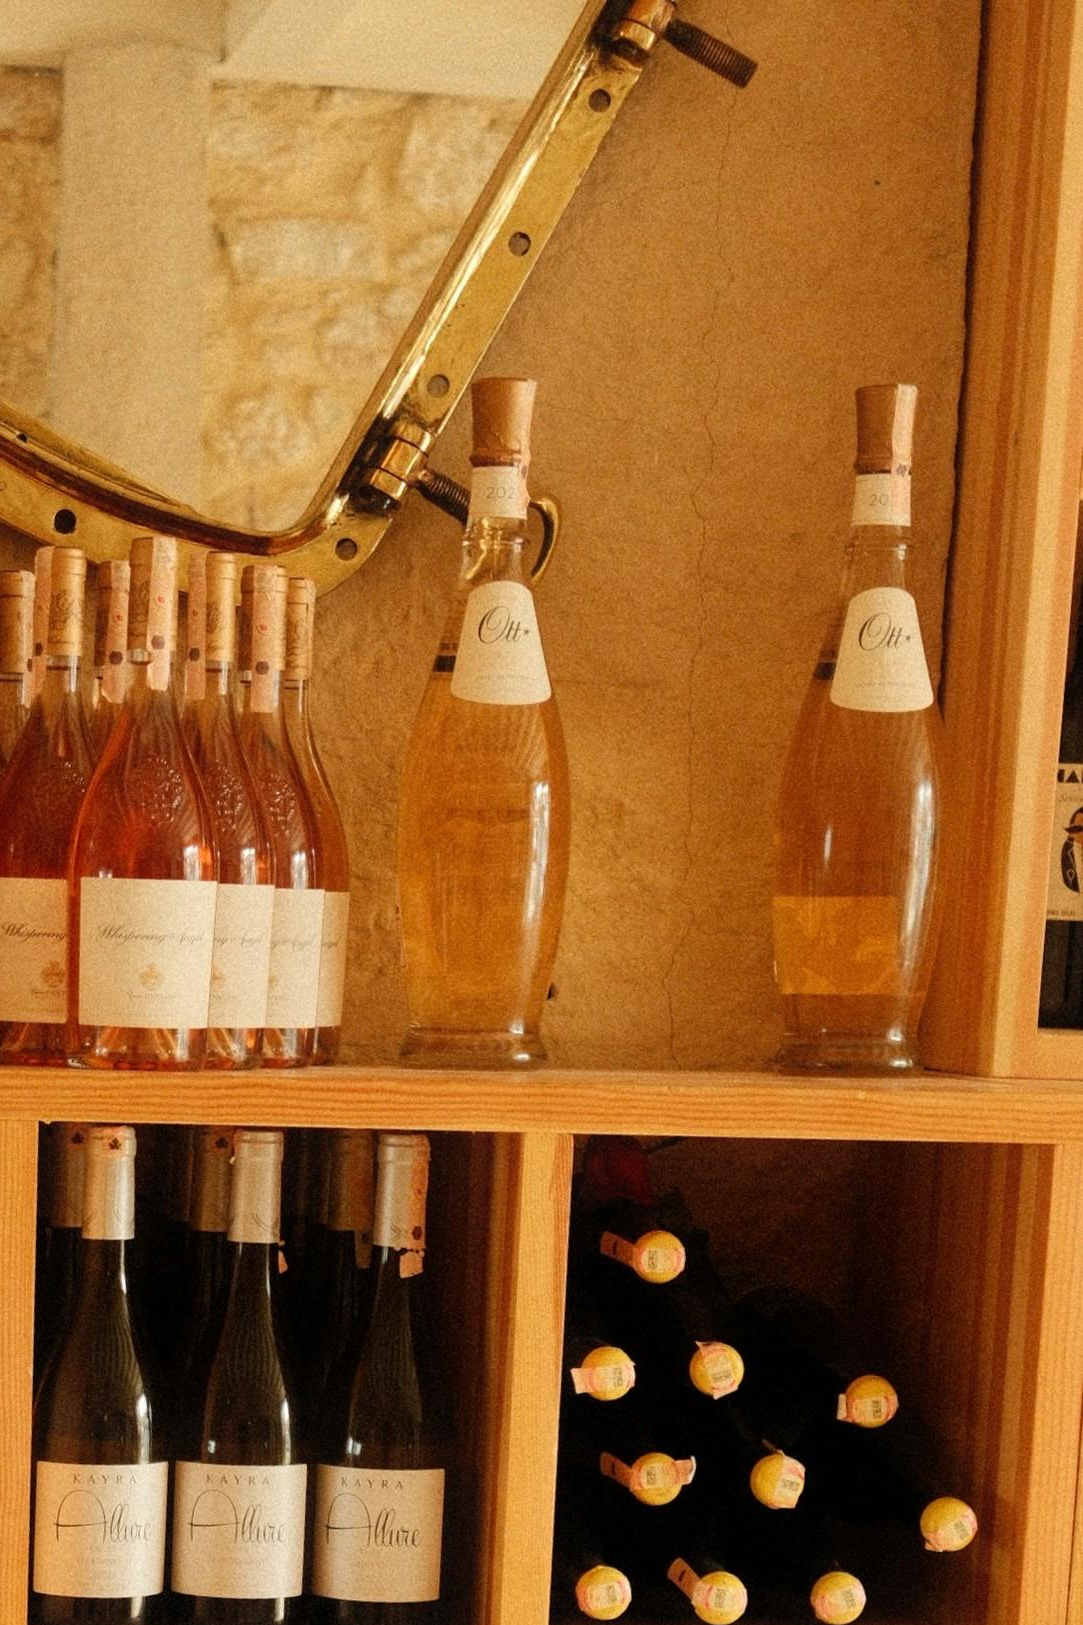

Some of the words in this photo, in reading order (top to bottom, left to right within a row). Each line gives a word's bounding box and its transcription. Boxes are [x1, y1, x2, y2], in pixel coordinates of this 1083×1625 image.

[486, 486, 515, 499] 202
[478, 605, 522, 644] Ott
[859, 612, 903, 651] Ott
[95, 924, 166, 945] Whispering
[73, 1473, 138, 1485] KAYRA
[206, 1473, 271, 1486] KAYRA
[341, 1477, 404, 1490] KAYRA
[53, 1490, 150, 1544] Allure
[188, 1490, 287, 1544] Allure
[324, 1492, 422, 1548] Allure
